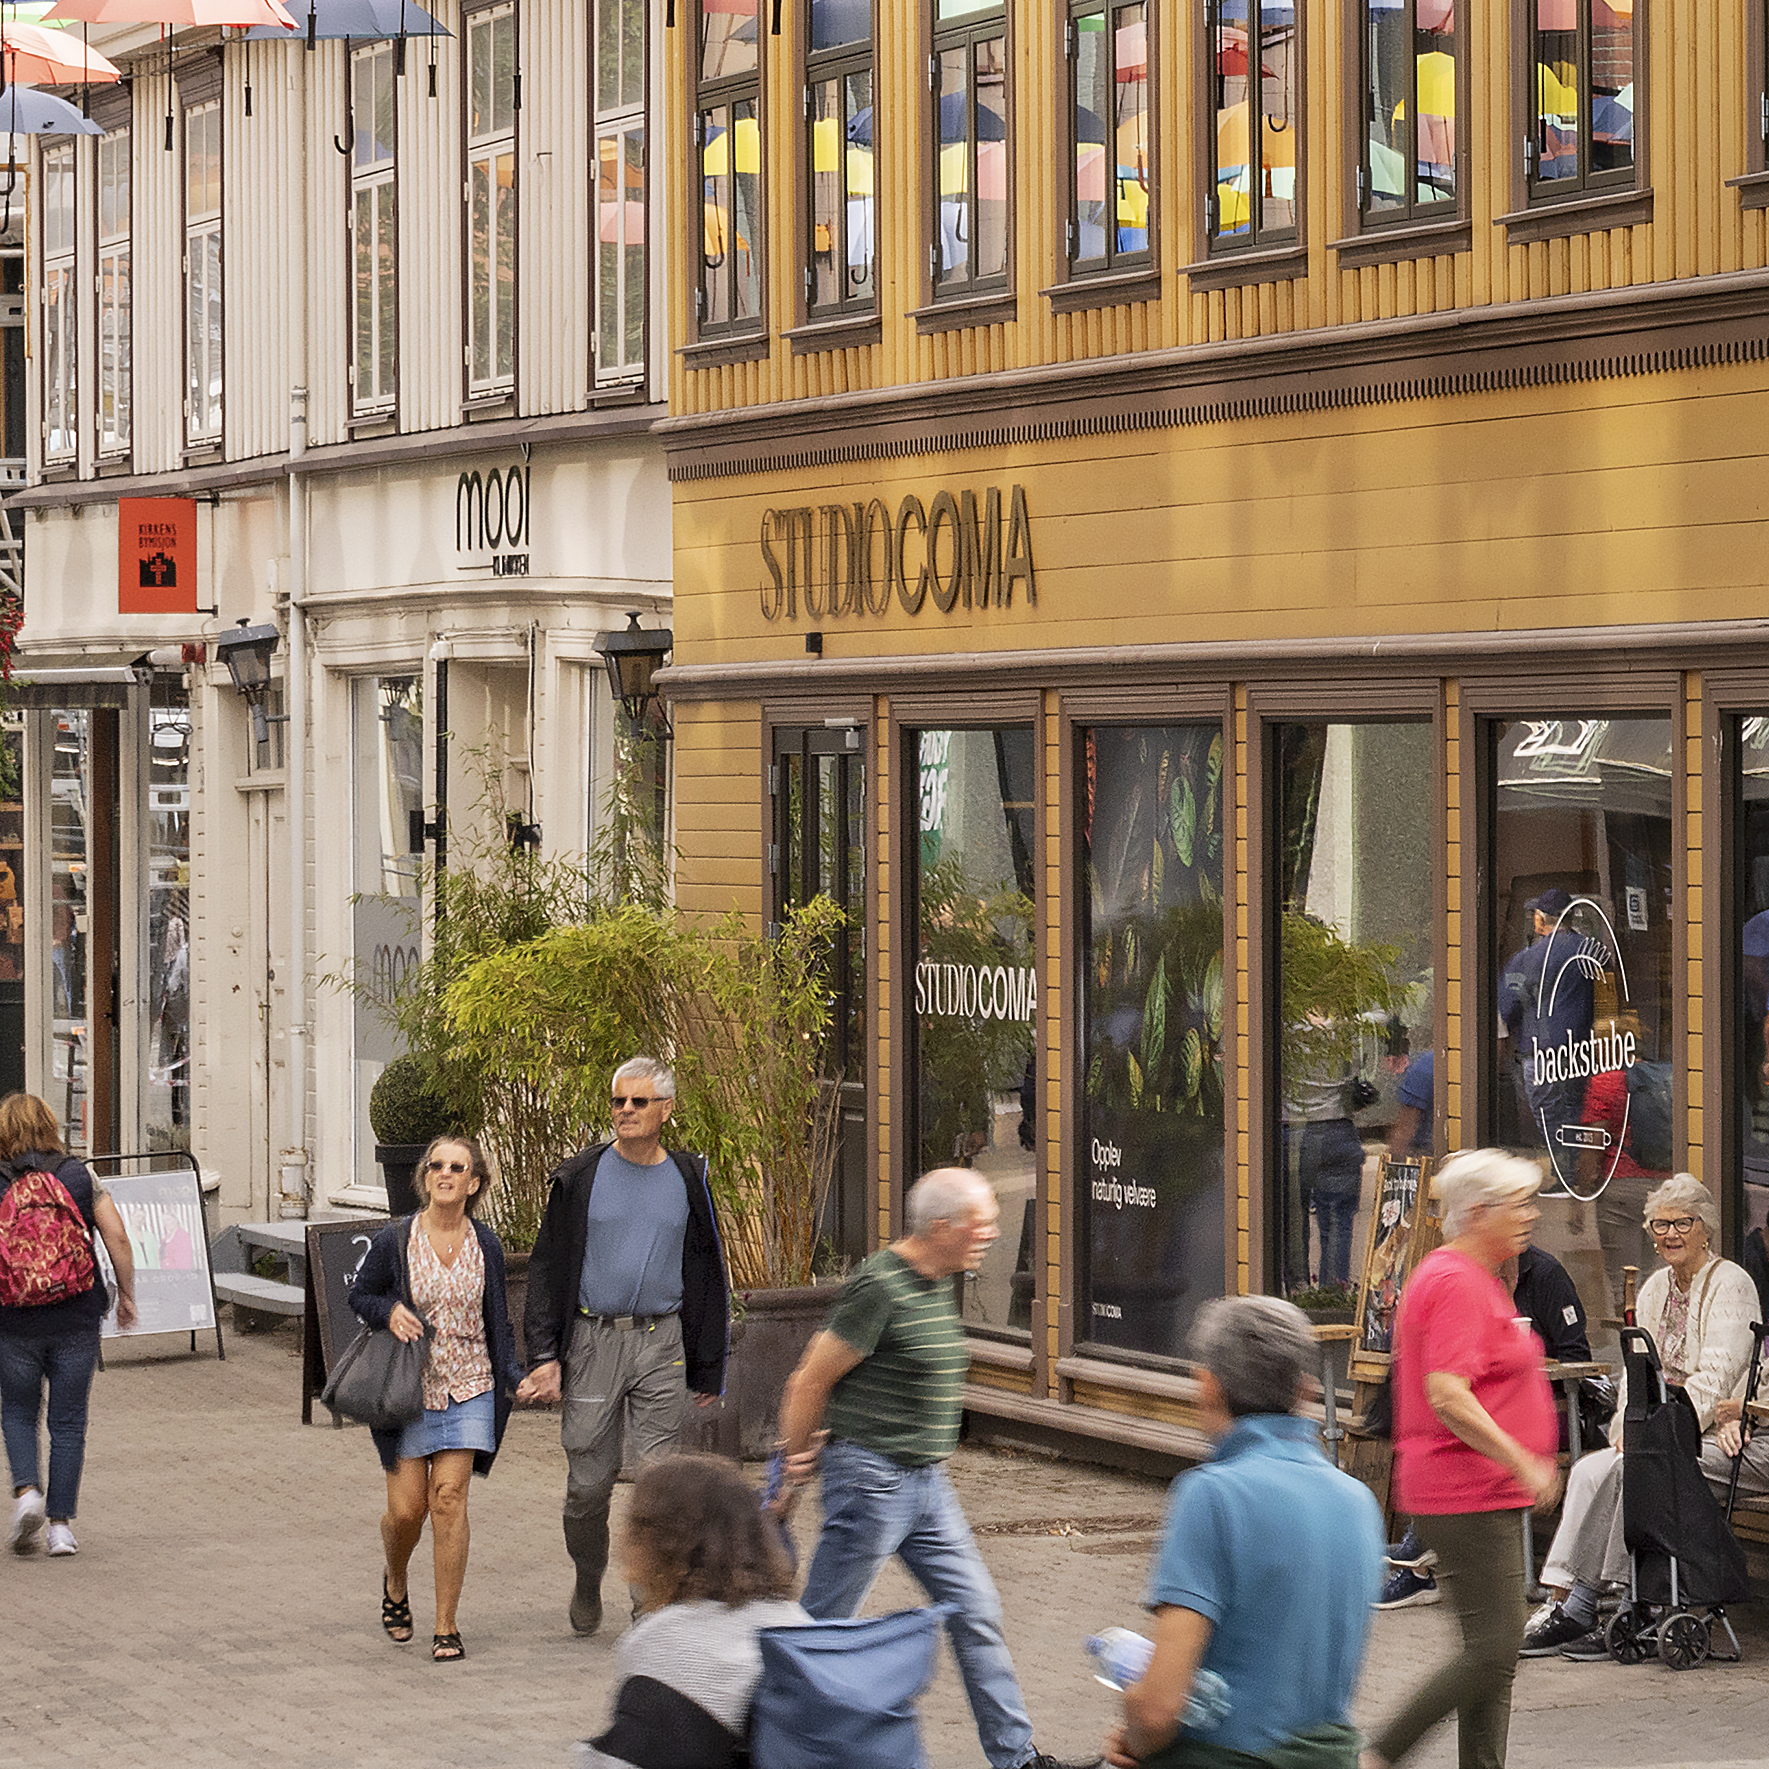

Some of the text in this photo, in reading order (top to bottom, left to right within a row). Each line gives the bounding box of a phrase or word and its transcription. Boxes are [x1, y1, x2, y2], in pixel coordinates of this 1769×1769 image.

[457, 442, 531, 552] mooi
[1531, 1020, 1636, 1086] backstube
[1091, 1137, 1122, 1172] Opplev
